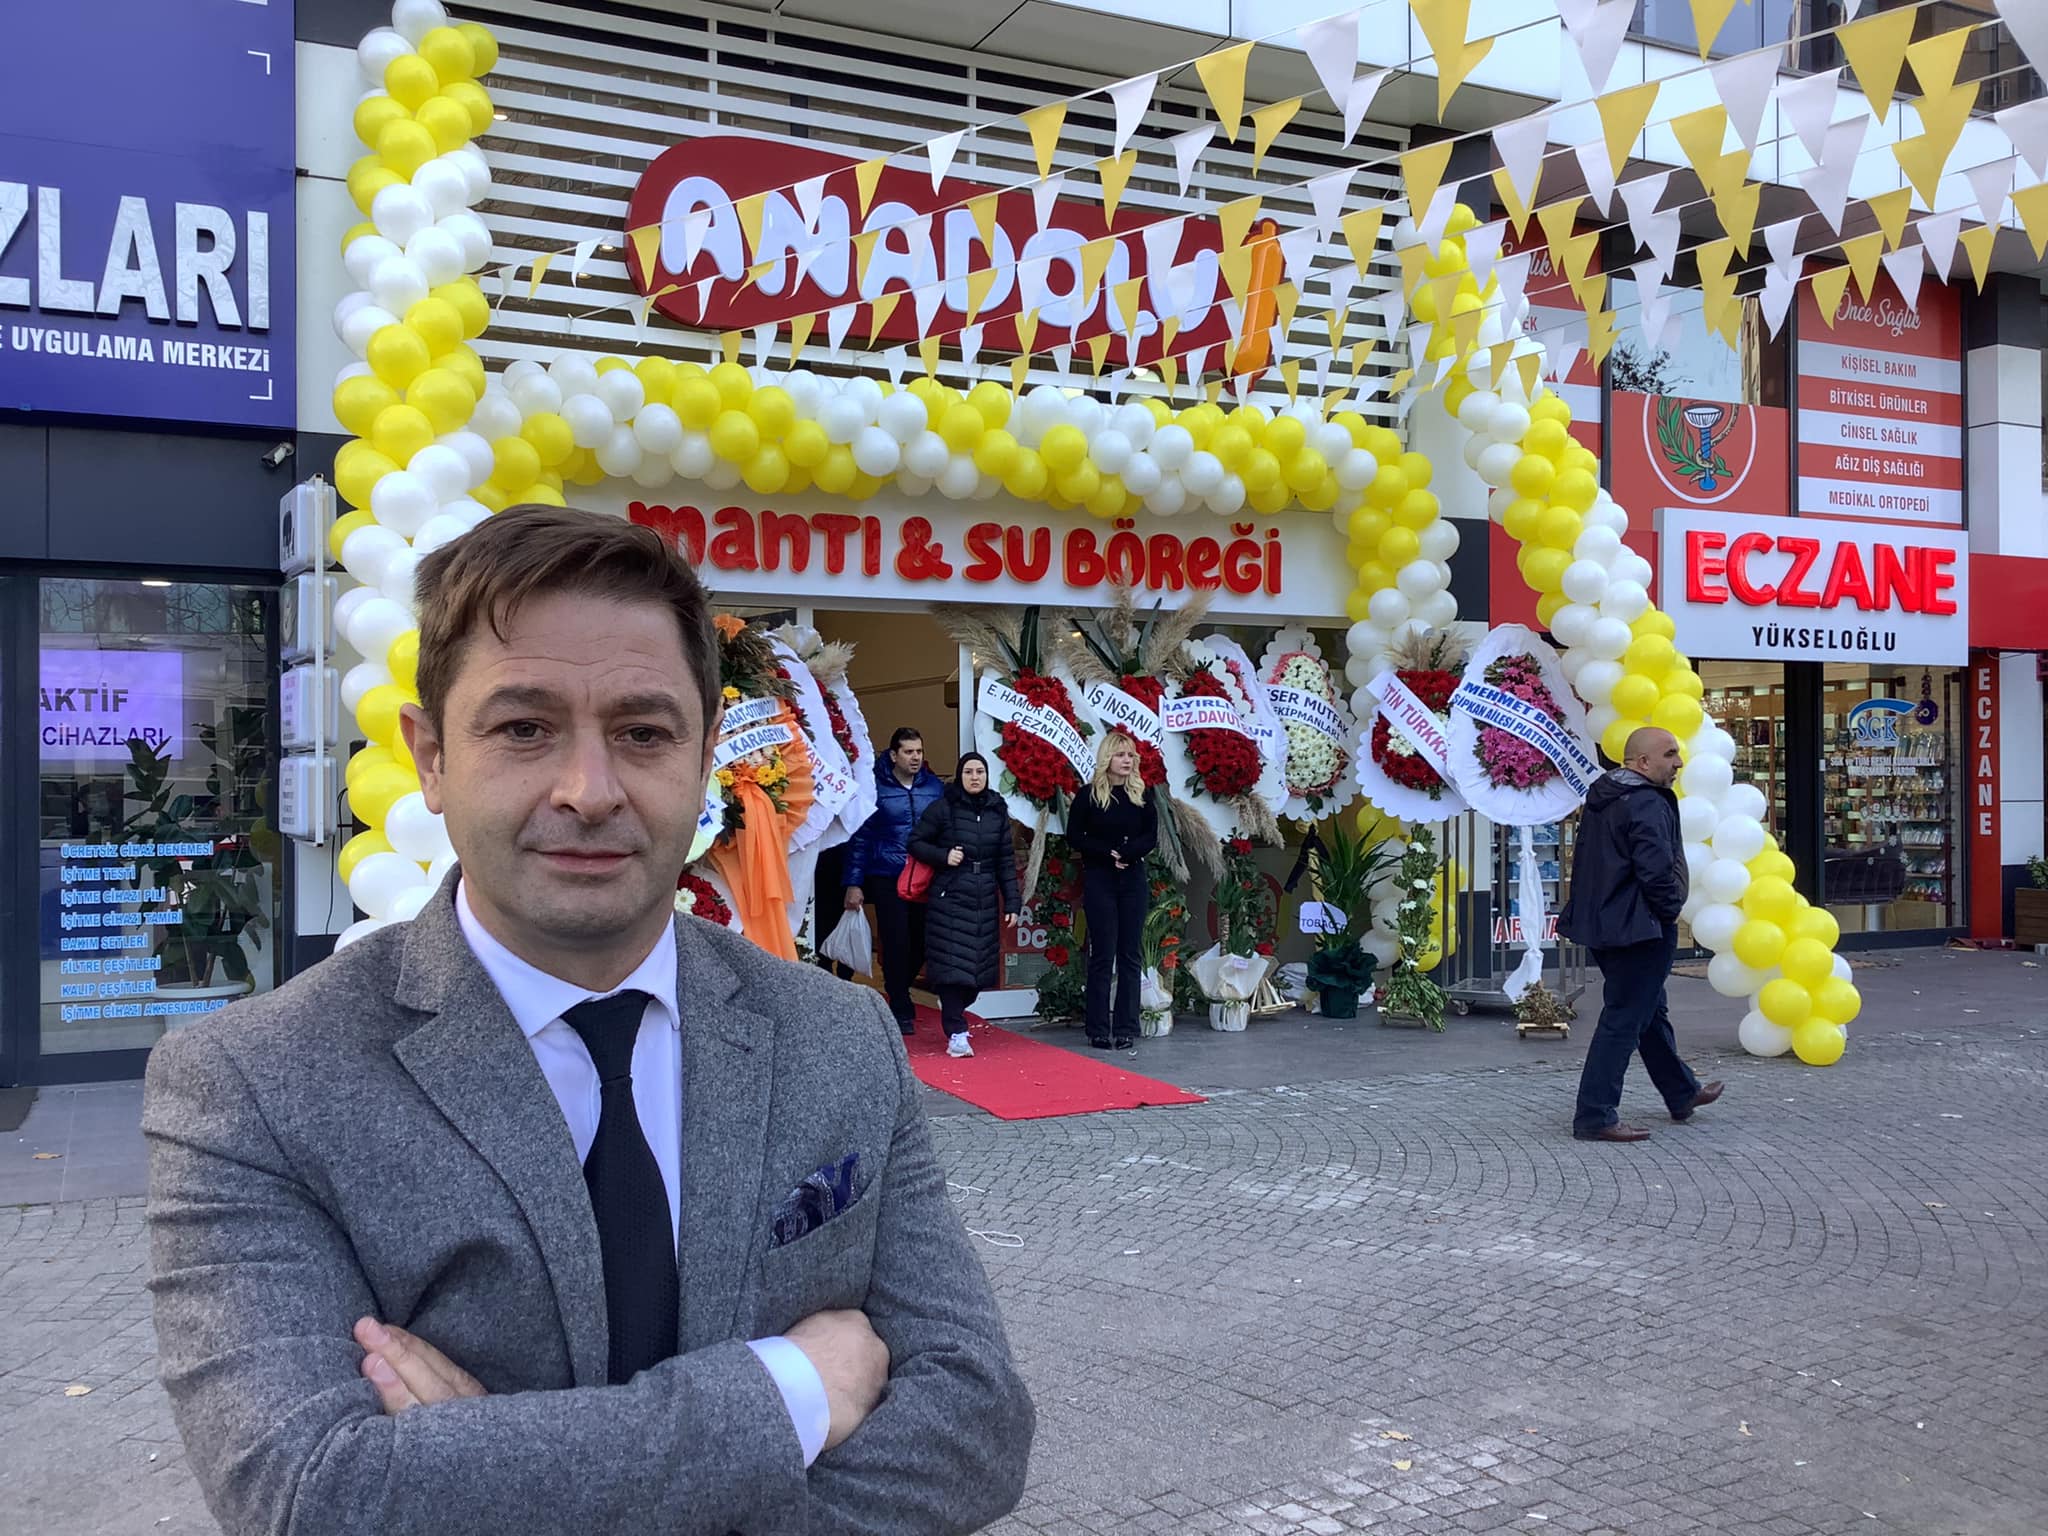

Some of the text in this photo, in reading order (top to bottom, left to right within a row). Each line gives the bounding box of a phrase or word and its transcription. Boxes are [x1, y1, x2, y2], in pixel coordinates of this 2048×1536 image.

[660, 176, 1219, 337] ANADOLU
[1836, 287, 1873, 321] Önce
[12, 326, 154, 363] UYGULAMA
[1841, 353, 1917, 378] KİŞİSEL BAKIM
[1830, 387, 1928, 414] BİTKİSEL ÜRÜNLER
[1841, 422, 1918, 445] CİNSEL SAĞLIK
[1835, 453, 1924, 477] AĞIZ DİŞ SAĞLIĞI
[1829, 489, 1930, 512] MEDİKAL ORTOPEDİ
[895, 516, 953, 581] &
[963, 522, 1051, 583] SU
[1686, 530, 1957, 616] ECZANE
[1752, 623, 1896, 651] YÜKSELOĞLU
[1088, 684, 1152, 733] İŞ İNSANI
[1267, 688, 1299, 704] SER
[42, 723, 164, 746] CİHAZLARI
[1464, 682, 1598, 775] MEHMET BOZKURT
[1513, 721, 1561, 760] PLATFORM
[1856, 716, 1899, 739] SGK
[1977, 668, 1993, 835] ECZANE
[61, 983, 96, 998] KALIP
